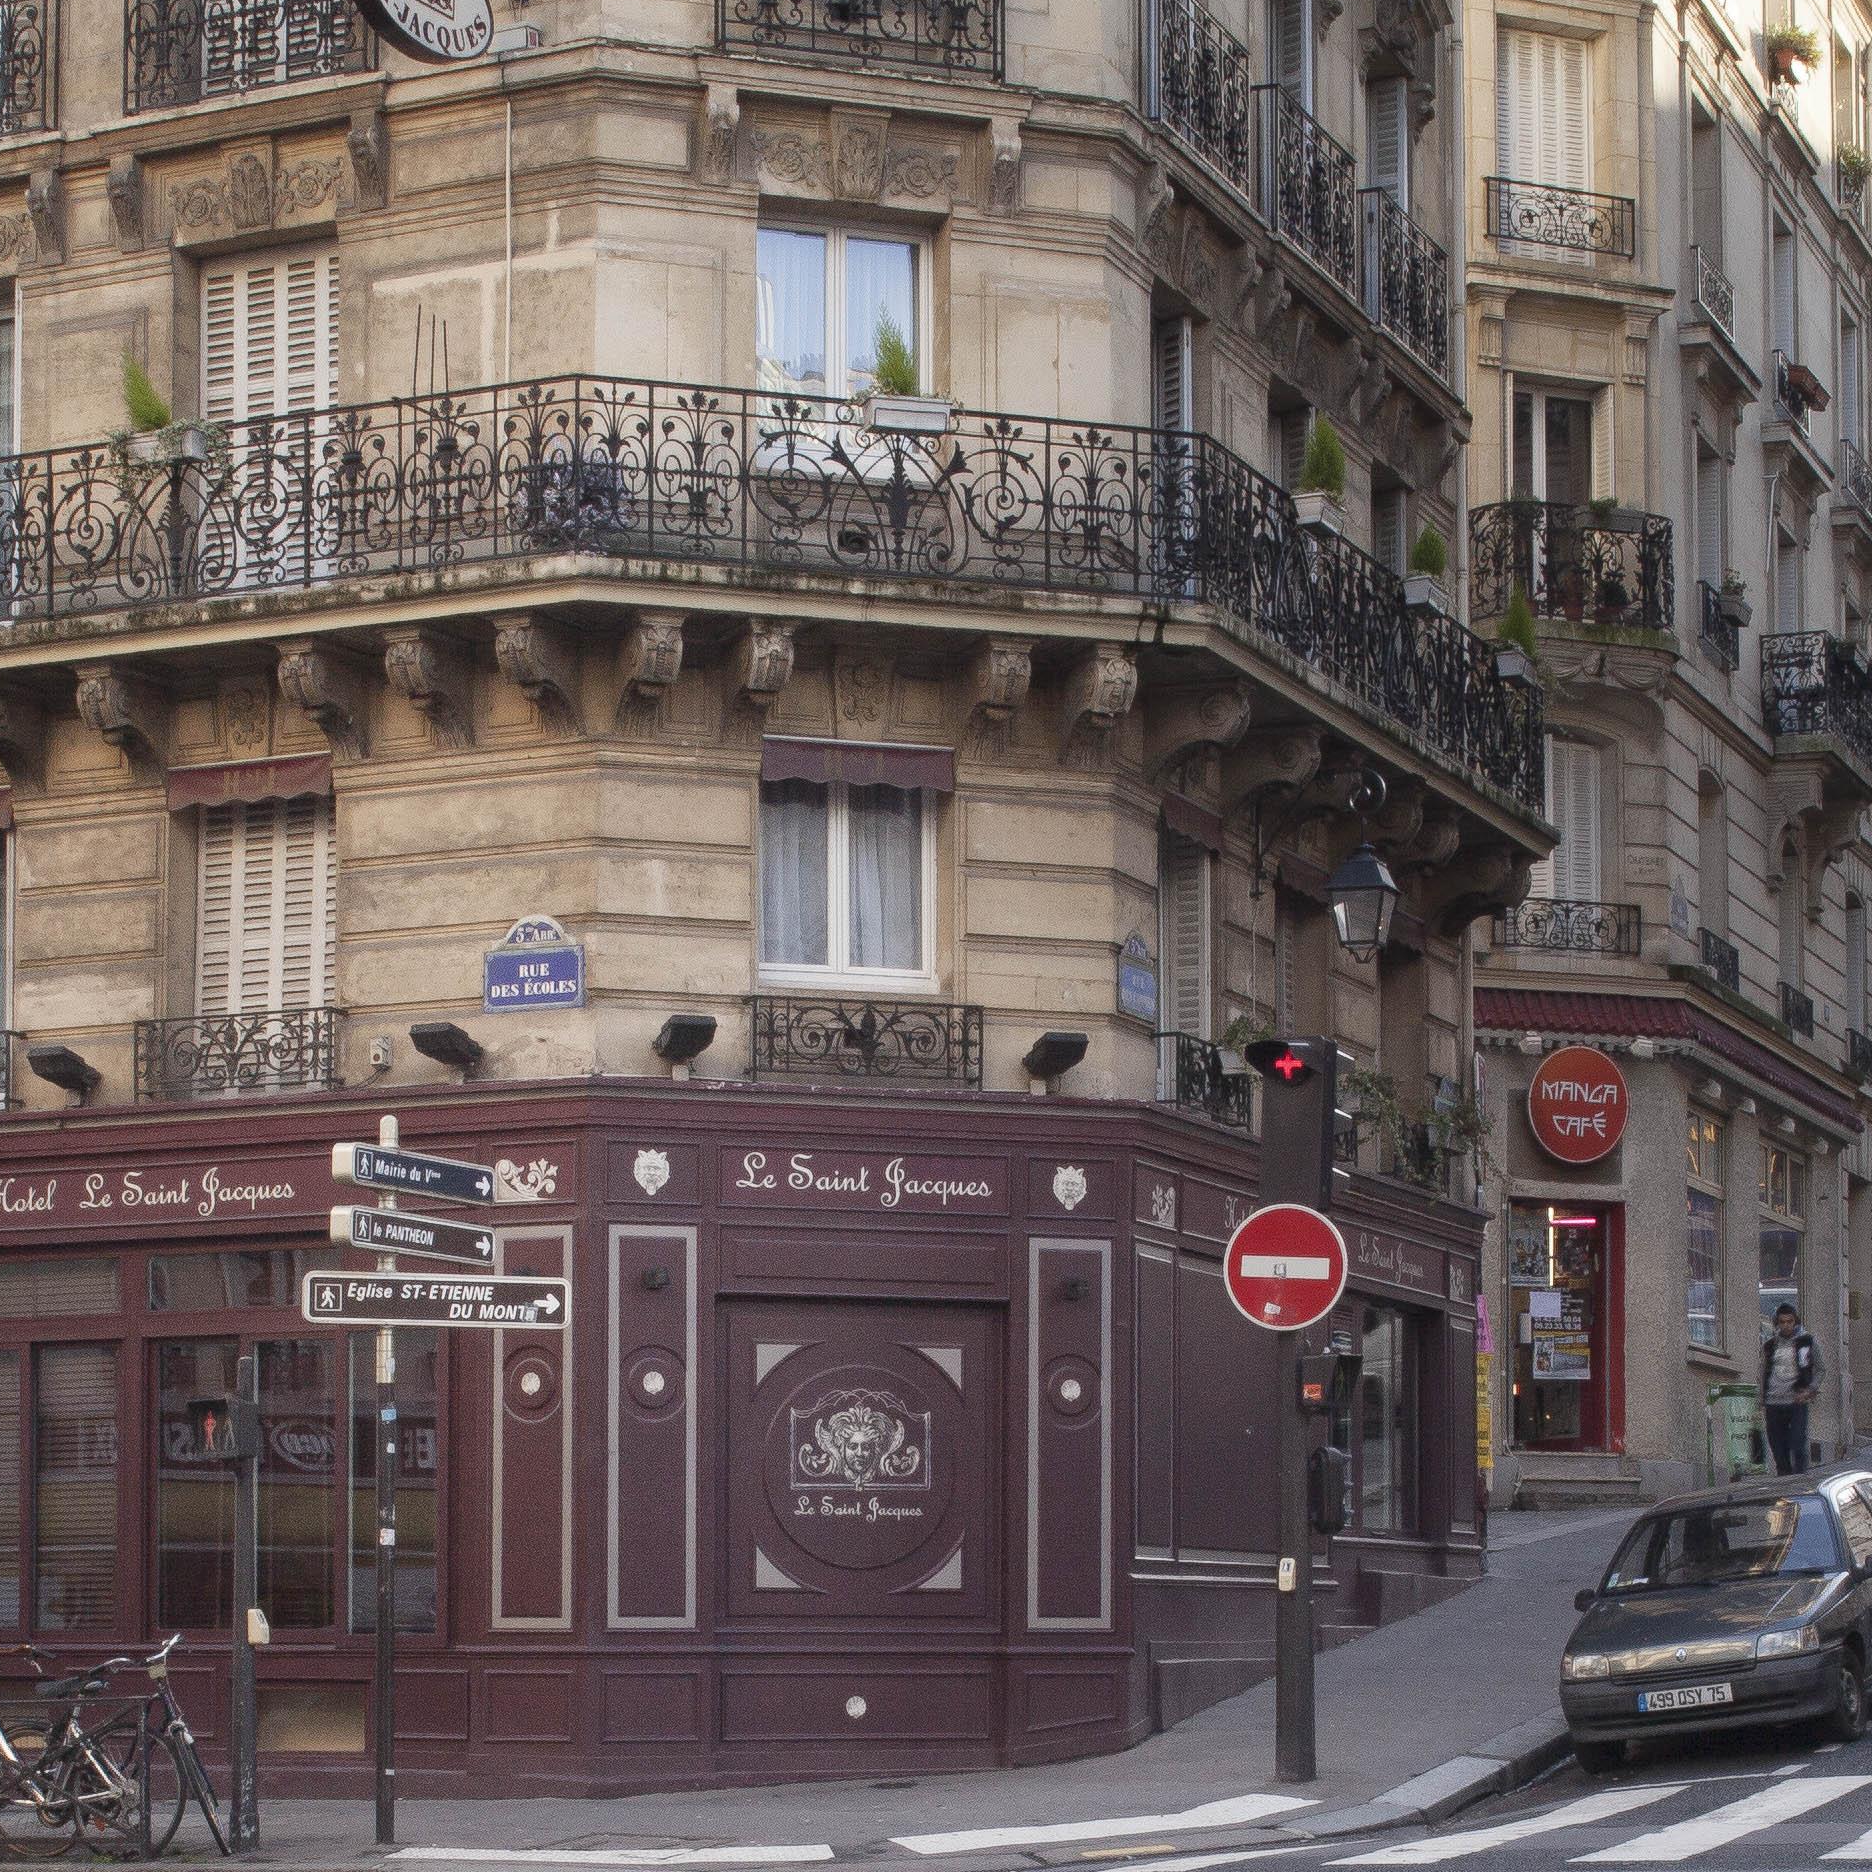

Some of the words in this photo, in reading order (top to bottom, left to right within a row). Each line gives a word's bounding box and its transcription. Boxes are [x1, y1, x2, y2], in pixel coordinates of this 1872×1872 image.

[519, 963, 550, 978] RUE
[491, 984, 519, 998] DES
[524, 978, 577, 996] ÉCOLES
[1542, 1080, 1617, 1105] MANGA
[1553, 1111, 1606, 1137] CAFÉ
[375, 1159, 407, 1179] Mairie
[409, 1168, 422, 1183] du
[736, 1152, 777, 1188] Le
[788, 1154, 870, 1192] Saint
[880, 1157, 993, 1207] Jacques
[78, 1173, 113, 1209] Le
[122, 1171, 190, 1206] Saint
[198, 1166, 295, 1216] Jacques
[373, 1221, 382, 1237] le
[385, 1224, 434, 1246] PANTHEON
[1357, 1233, 1370, 1264] Le
[347, 1283, 393, 1302] Eglise
[449, 1304, 473, 1319] DU
[479, 1304, 527, 1320] MONT
[794, 1496, 816, 1516] Le
[820, 1495, 862, 1516] Saint
[866, 1497, 924, 1522] Jacques
[1649, 1692, 1675, 1708] 499
[1708, 1685, 1725, 1701] 75
